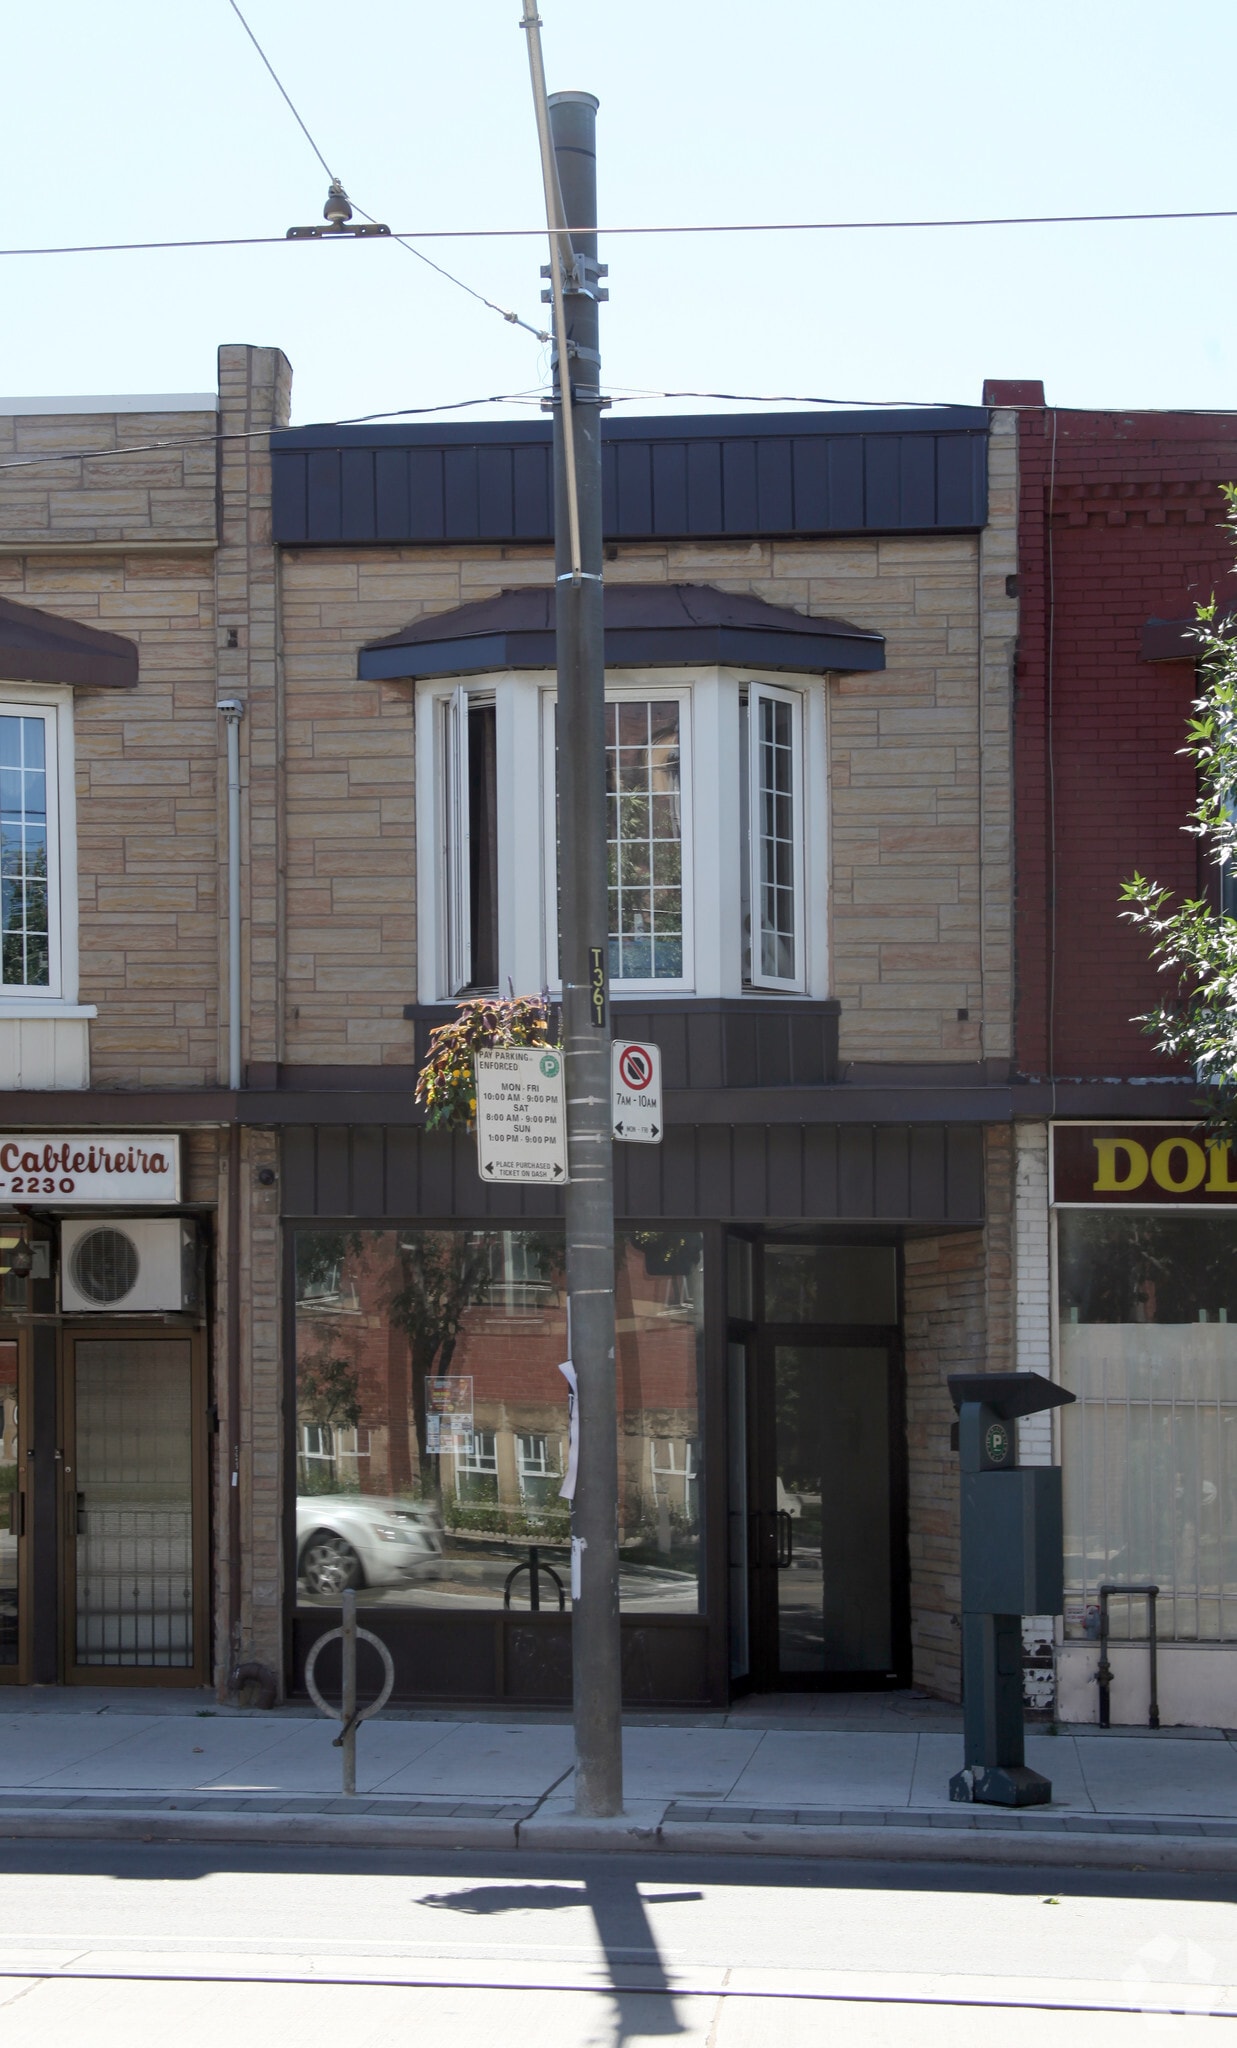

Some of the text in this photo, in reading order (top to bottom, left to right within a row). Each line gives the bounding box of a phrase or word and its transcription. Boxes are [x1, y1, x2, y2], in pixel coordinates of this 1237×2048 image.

[591, 948, 604, 1025] T361
[479, 1051, 529, 1062] PAY PARKING
[479, 1061, 519, 1071] ENFORCED
[544, 1060, 555, 1072] P
[501, 1083, 521, 1091] MON
[526, 1084, 540, 1092] FRI
[483, 1092, 506, 1101] 10:00
[507, 1093, 521, 1102] AM
[526, 1095, 544, 1103] 9:00
[616, 1092, 631, 1106] 7AM
[638, 1095, 657, 1108] 10AM
[513, 1104, 529, 1112] SAT
[506, 1114, 520, 1122] AM
[525, 1115, 543, 1123] 9:00
[544, 1116, 557, 1124] PM
[513, 1124, 531, 1132] SUN
[488, 1134, 505, 1142] 1:00
[506, 1134, 519, 1142] PM
[525, 1135, 543, 1143] 9:00
[544, 1136, 557, 1144] PM
[0, 1143, 169, 1174] Cableireira
[515, 1161, 551, 1169] PURCHASED
[1092, 1137, 1237, 1193] DOL
[993, 1434, 1002, 1448] P
